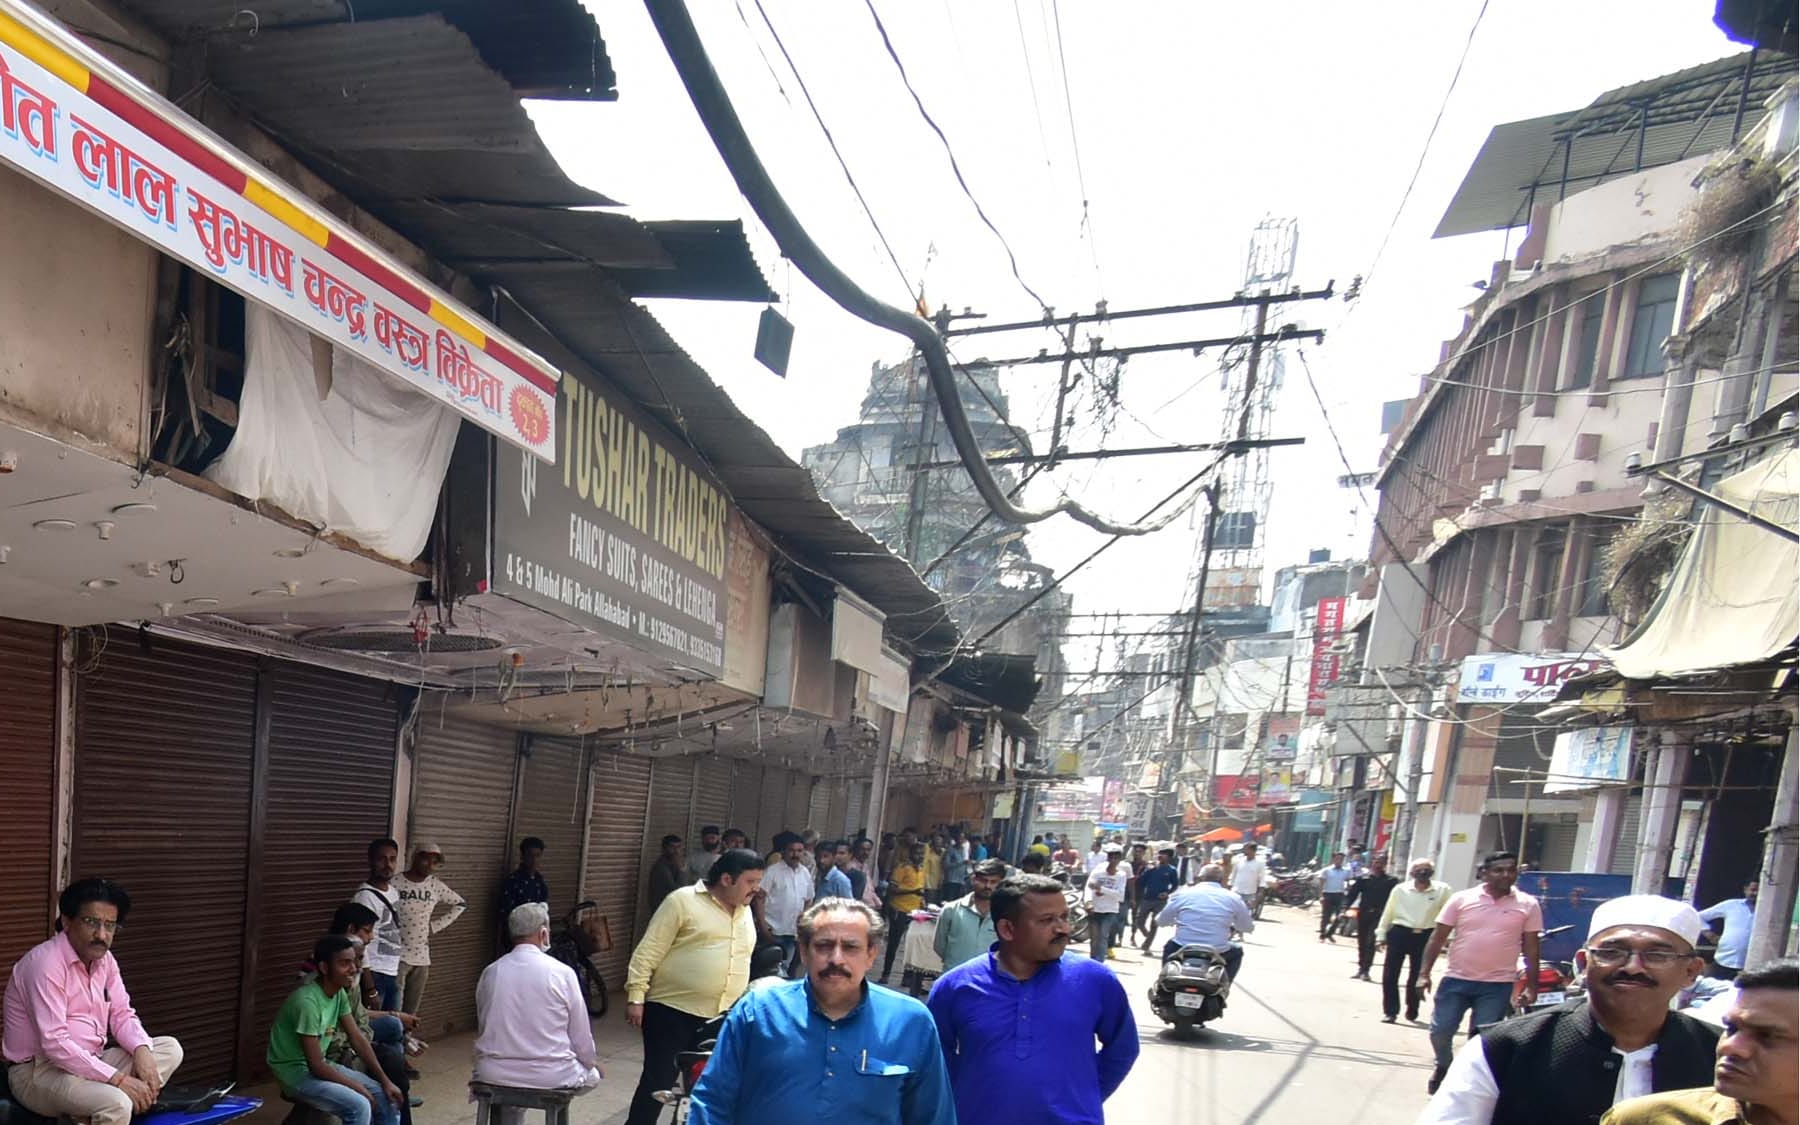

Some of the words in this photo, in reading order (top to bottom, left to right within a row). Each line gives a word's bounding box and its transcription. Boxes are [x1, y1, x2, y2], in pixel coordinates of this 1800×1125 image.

[70, 112, 177, 226] लाल
[187, 187, 294, 295] सुभाष
[302, 257, 367, 340] चन्द्र
[373, 301, 430, 373] वस्त्र
[435, 329, 503, 414] विक्रेता
[563, 371, 650, 535] TUSHAR
[654, 443, 727, 582] TRADERS
[506, 553, 514, 581] 4
[516, 560, 524, 585] &
[526, 562, 533, 589] 5
[535, 565, 560, 601] Mohd
[561, 576, 573, 607] Ali
[574, 582, 593, 614] Park
[569, 512, 605, 572] FANCY
[607, 533, 639, 593] SUITS,
[641, 552, 674, 607] SAREES
